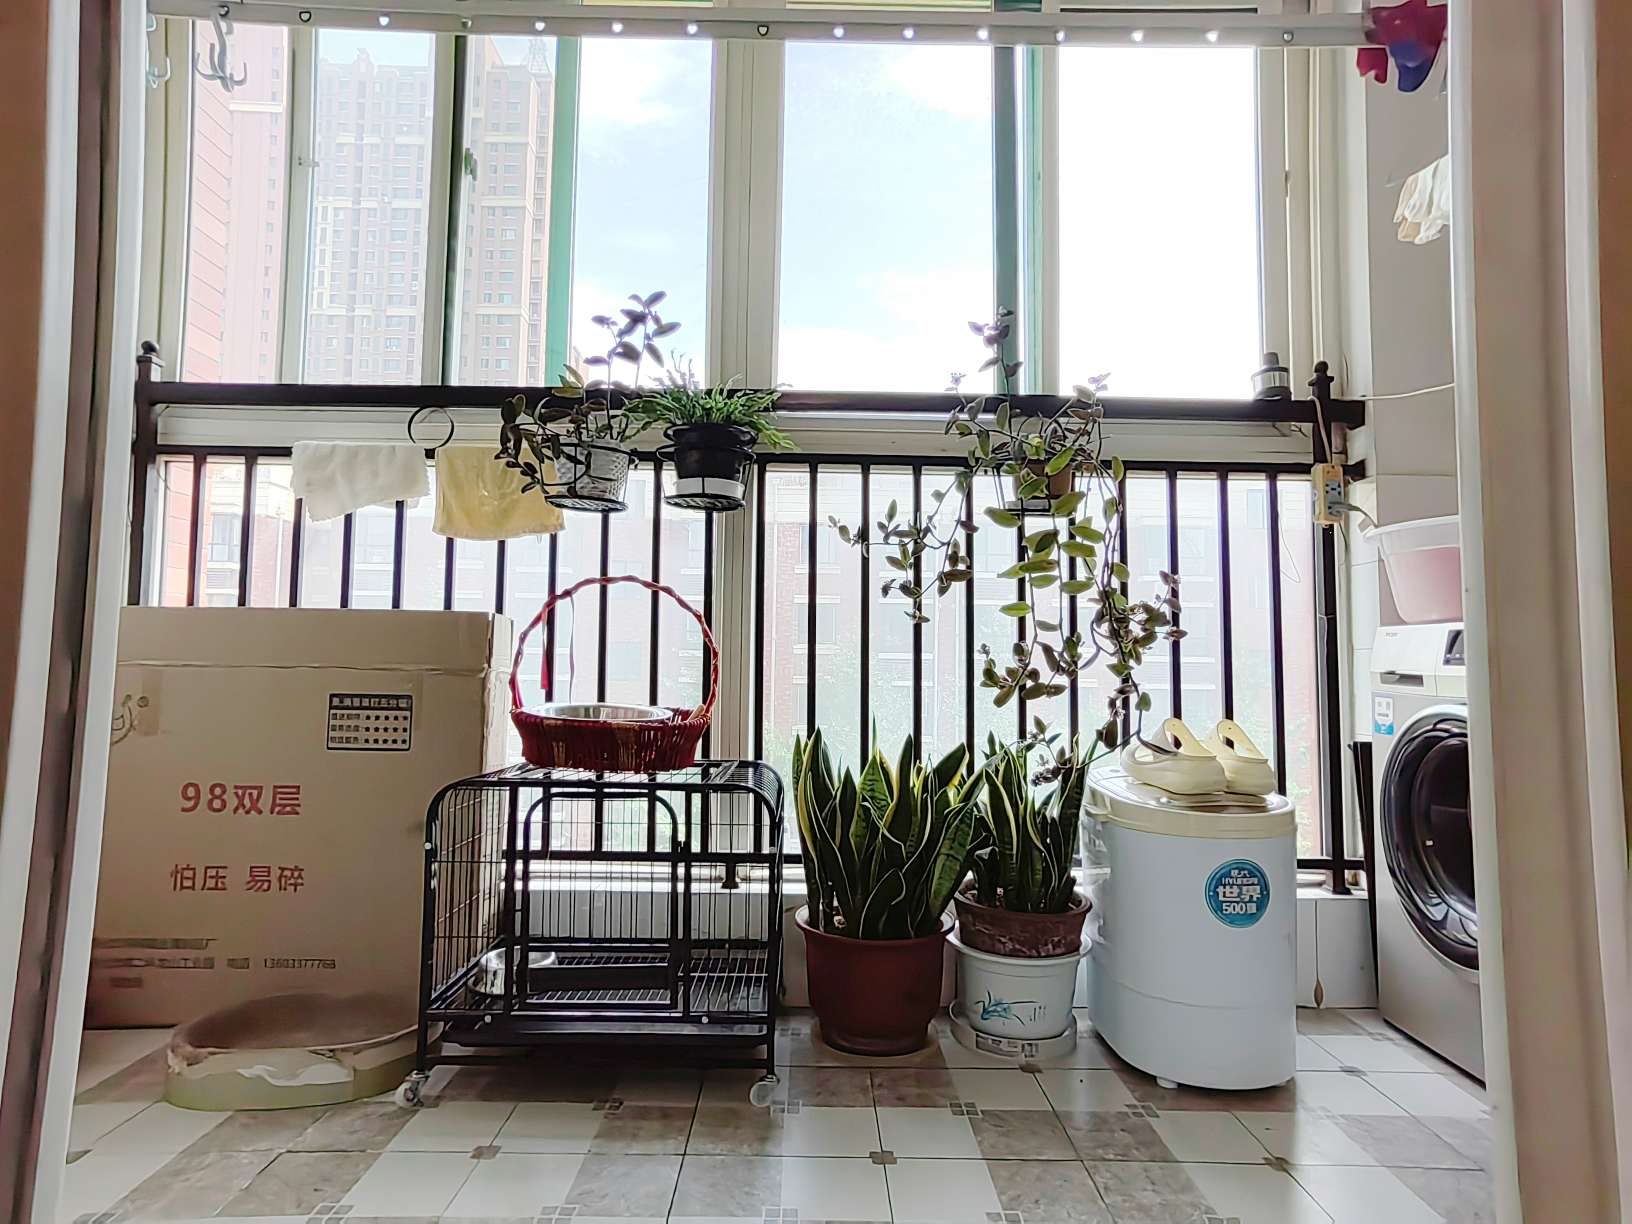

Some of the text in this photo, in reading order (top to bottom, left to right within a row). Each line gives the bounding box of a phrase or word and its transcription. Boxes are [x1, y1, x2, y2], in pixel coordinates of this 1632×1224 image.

[180, 782, 302, 816] 98双层
[170, 864, 305, 893] 怕压 易碎
[1216, 885, 1261, 901] 世界
